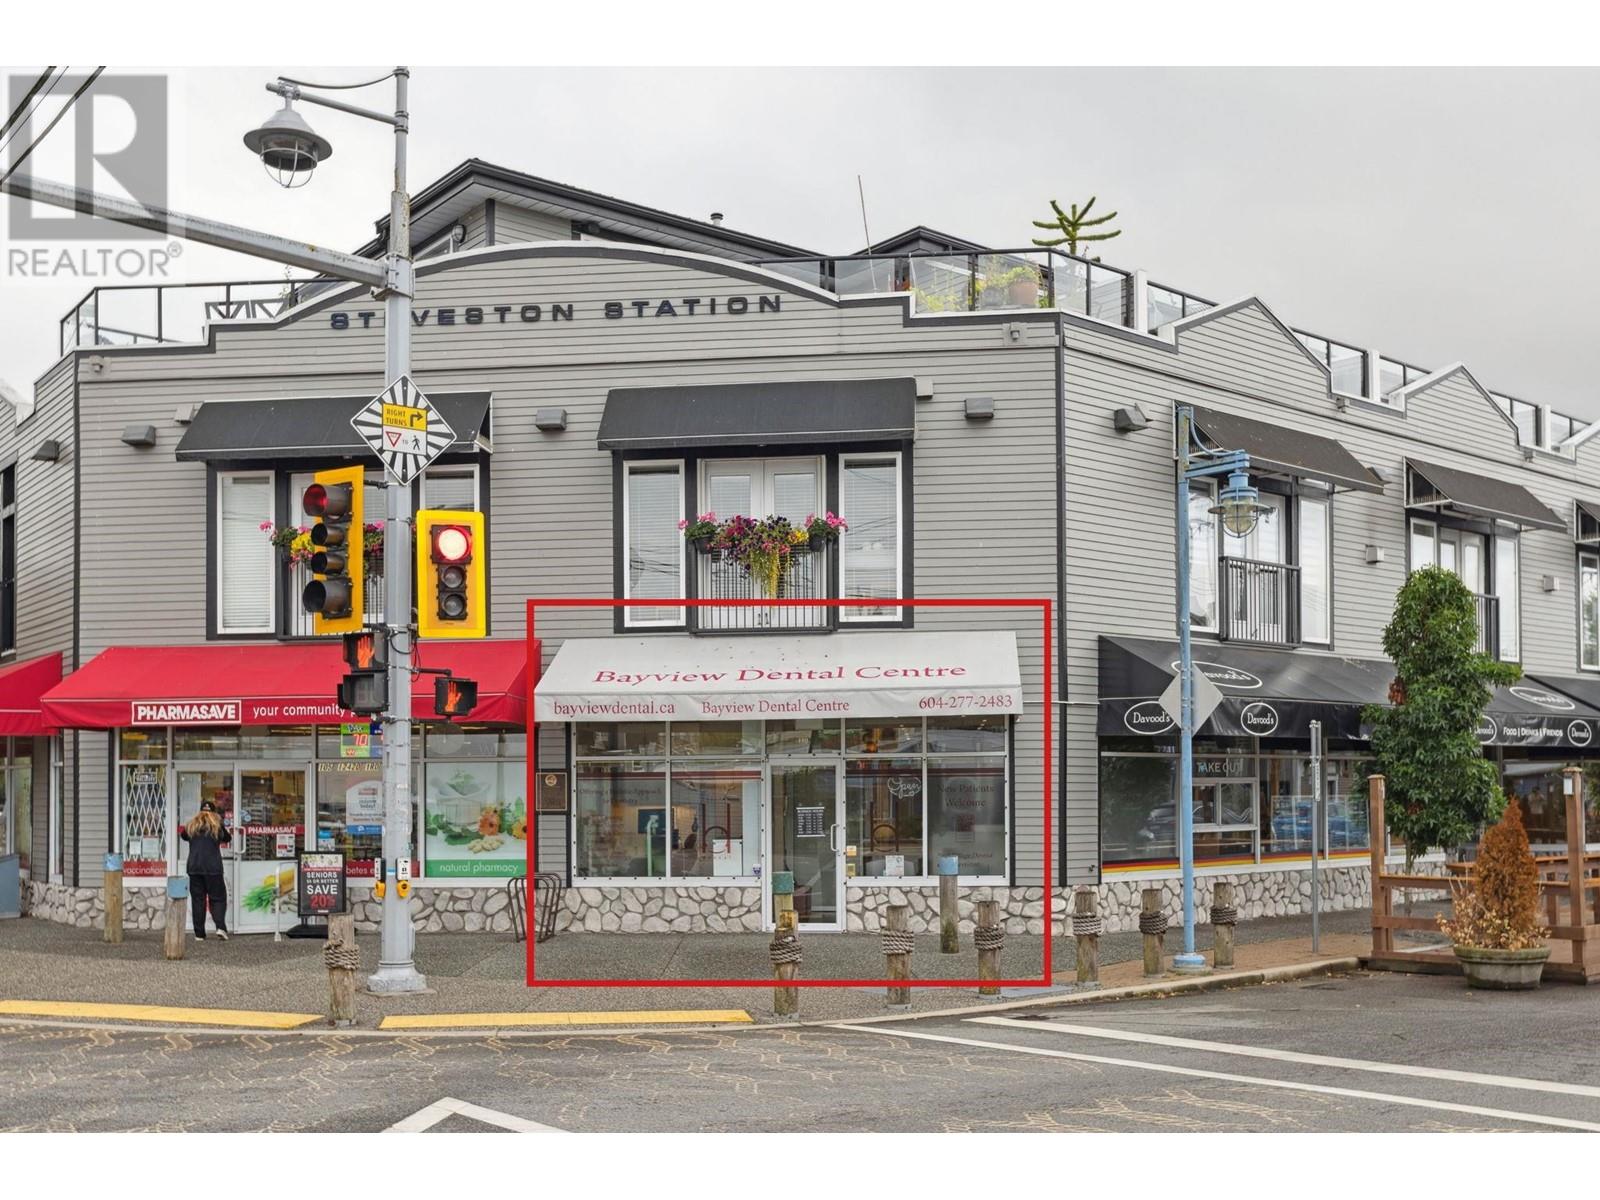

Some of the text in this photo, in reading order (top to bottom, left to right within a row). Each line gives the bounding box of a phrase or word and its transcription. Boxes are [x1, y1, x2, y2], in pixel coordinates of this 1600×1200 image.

[330, 295, 782, 330] STVESTON STATION
[386, 408, 406, 417] RIGHT
[386, 417, 408, 427] TURNS
[591, 664, 967, 687] Bayview Dental Centre
[137, 703, 236, 721] PHARMASAVE
[253, 705, 278, 717] your
[283, 704, 346, 718] community
[553, 694, 1013, 718] bayviewdental.ca Bayview Dental Centre 604-277-2483
[1133, 711, 1170, 724] Davood's
[1247, 712, 1274, 725] Davood's
[353, 733, 368, 747] 70
[1196, 761, 1221, 773] TAKE
[889, 777, 921, 799] Open
[937, 783, 995, 793] New Patients
[945, 798, 986, 807] Welcome
[248, 826, 297, 835] PHARMASAVE
[439, 863, 519, 874] natural pharmacy
[307, 884, 338, 895] SAVE
